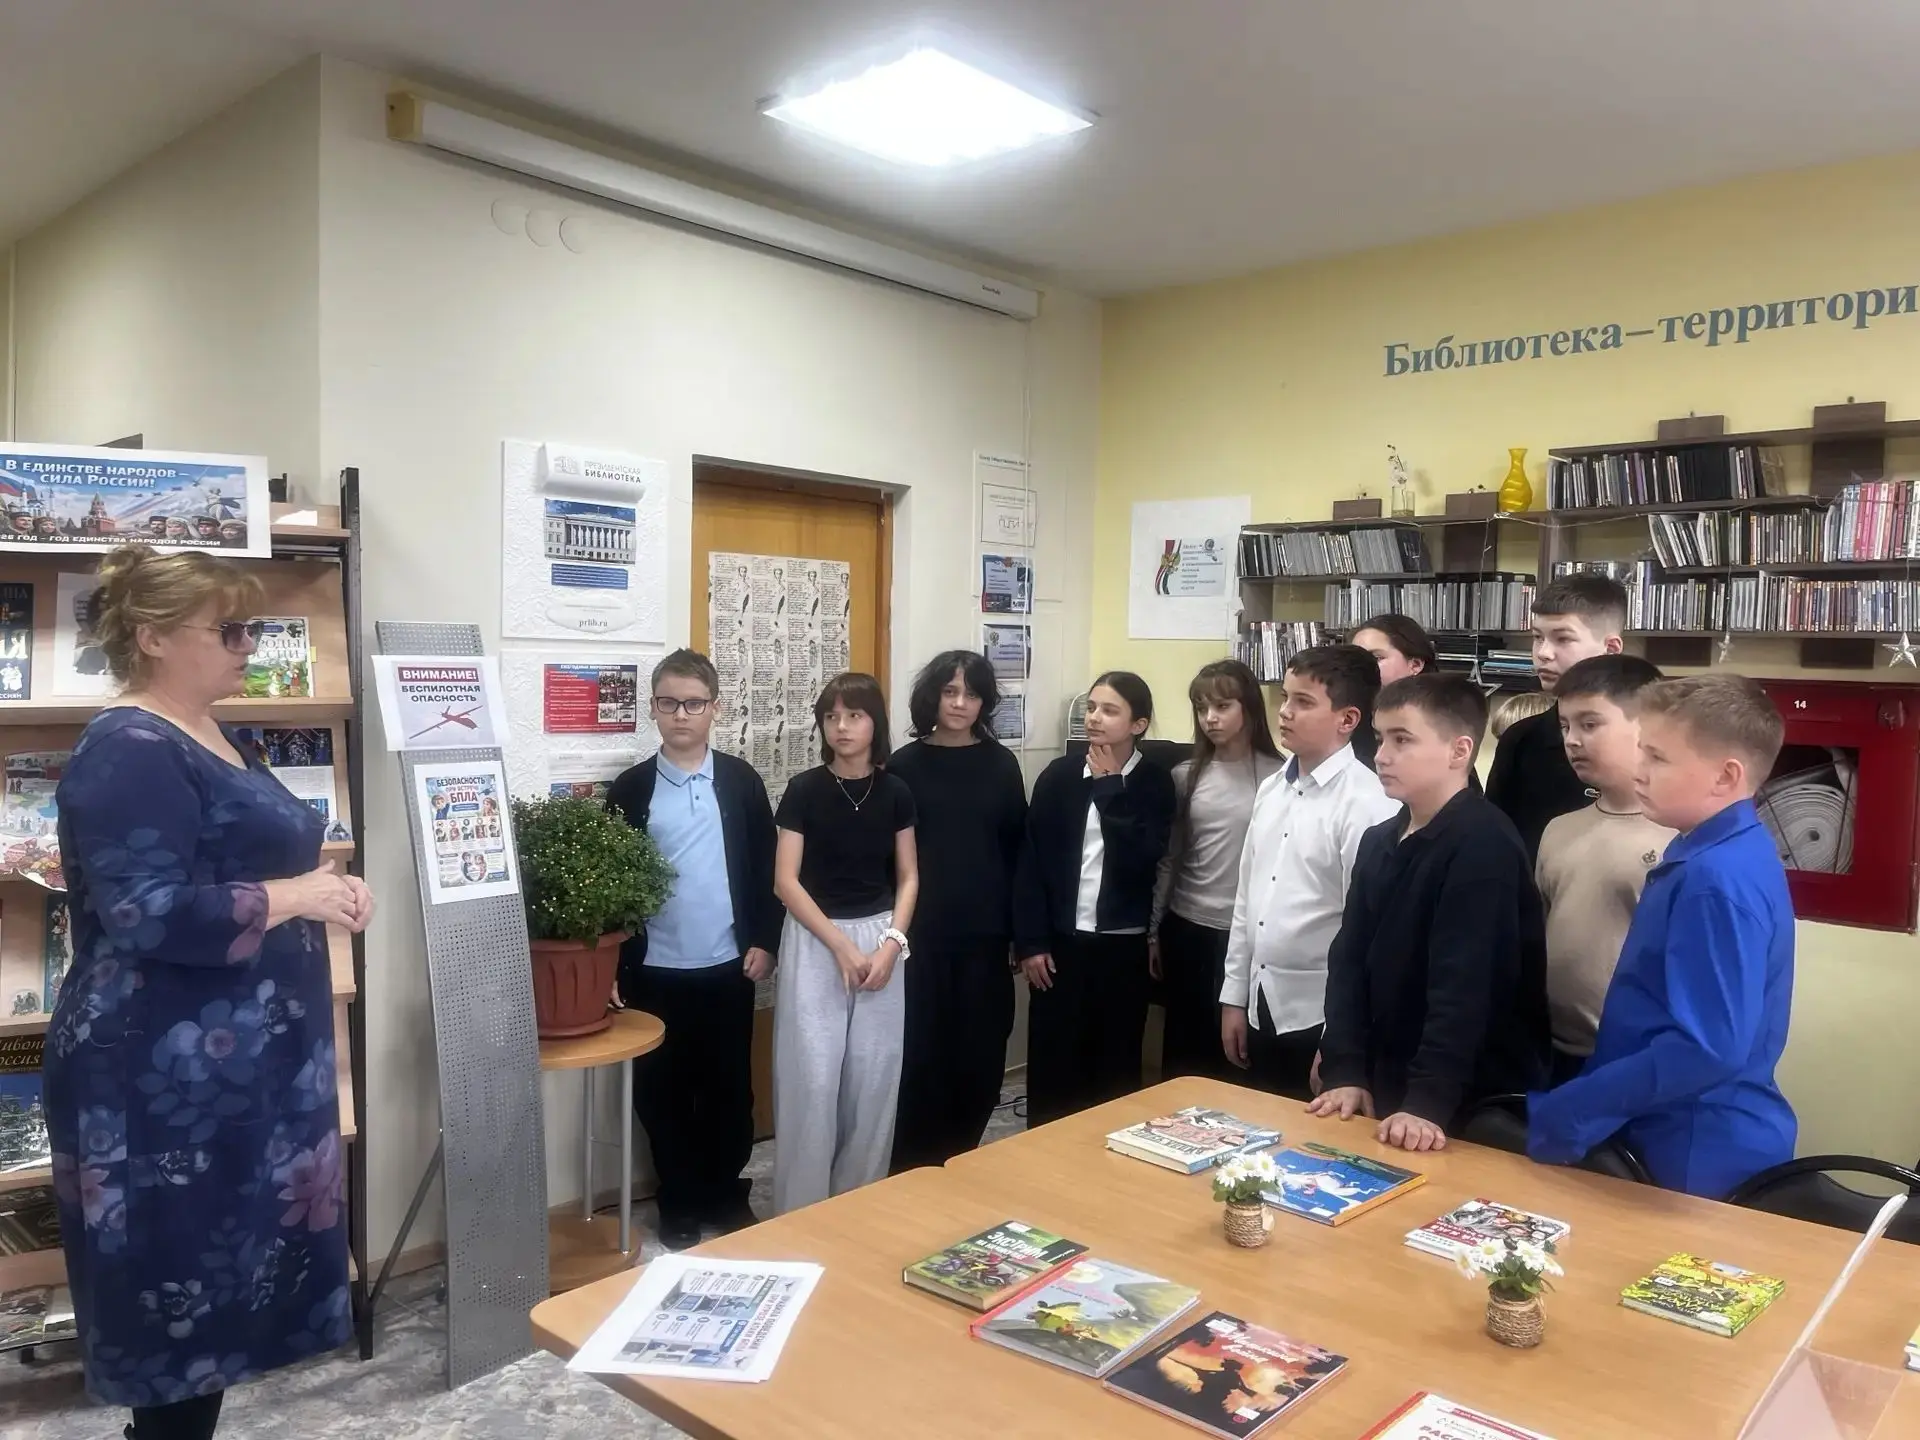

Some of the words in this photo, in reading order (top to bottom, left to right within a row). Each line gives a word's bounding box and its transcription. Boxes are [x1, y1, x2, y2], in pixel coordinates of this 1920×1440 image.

[5, 459, 17, 470] В
[22, 462, 103, 474] ЕДИНСТВЕ
[106, 466, 177, 478] НАРОДОВ
[584, 460, 641, 474] ПРЕЗИДЕНТСКАЯ
[40, 474, 82, 485] СИЛА
[585, 469, 641, 483] БИБЛИОТЕКА
[17, 534, 38, 542] ГОД
[49, 535, 70, 543] ГОД
[402, 670, 477, 680] ВНИМАНИЕ!
[401, 685, 481, 693] БЕСПИЛОТНАЯ
[411, 694, 477, 703] ОПАСНОСТЬ
[1794, 699, 1807, 710] 14
[436, 777, 486, 788] БЕЗОПАСНОСТЬ
[450, 791, 478, 803] БПЛА
